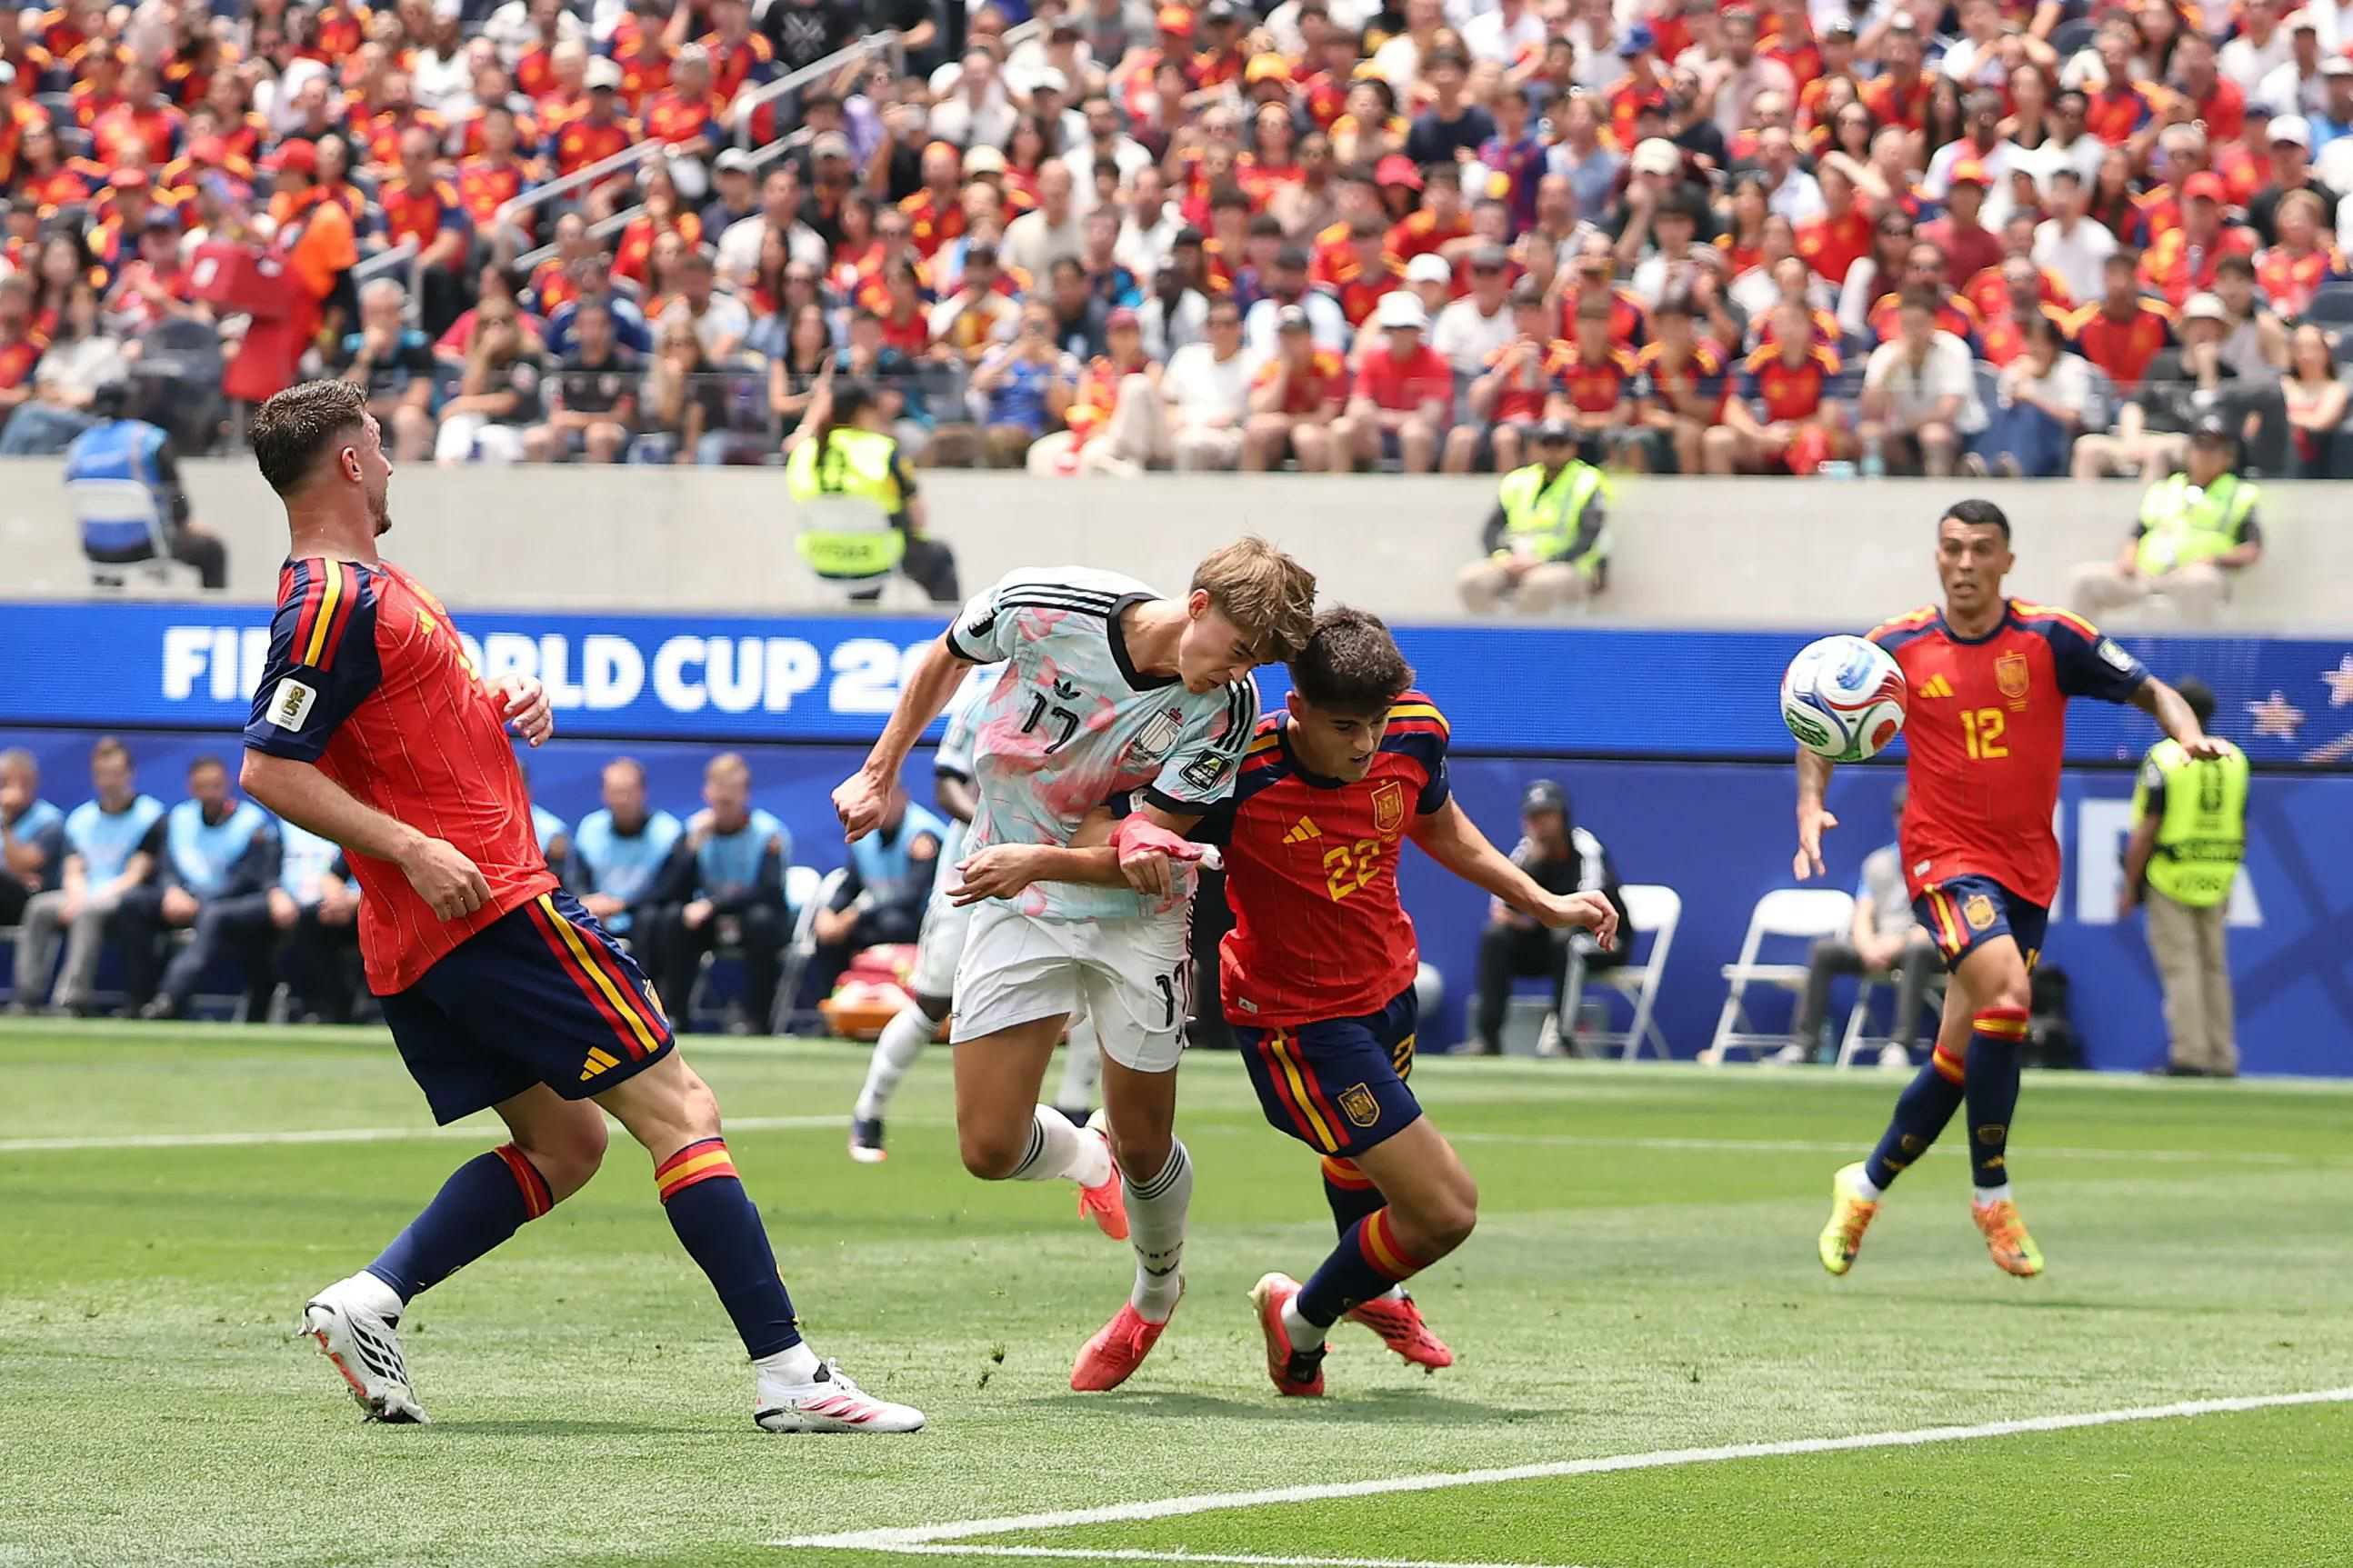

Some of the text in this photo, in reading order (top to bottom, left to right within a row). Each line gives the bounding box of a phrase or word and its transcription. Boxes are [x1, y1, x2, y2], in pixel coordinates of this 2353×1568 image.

[456, 631, 645, 708] RLD
[653, 634, 821, 714] CUP
[1021, 691, 1080, 754] 17
[1959, 706, 2008, 760] 12
[1323, 838, 1380, 903] 22
